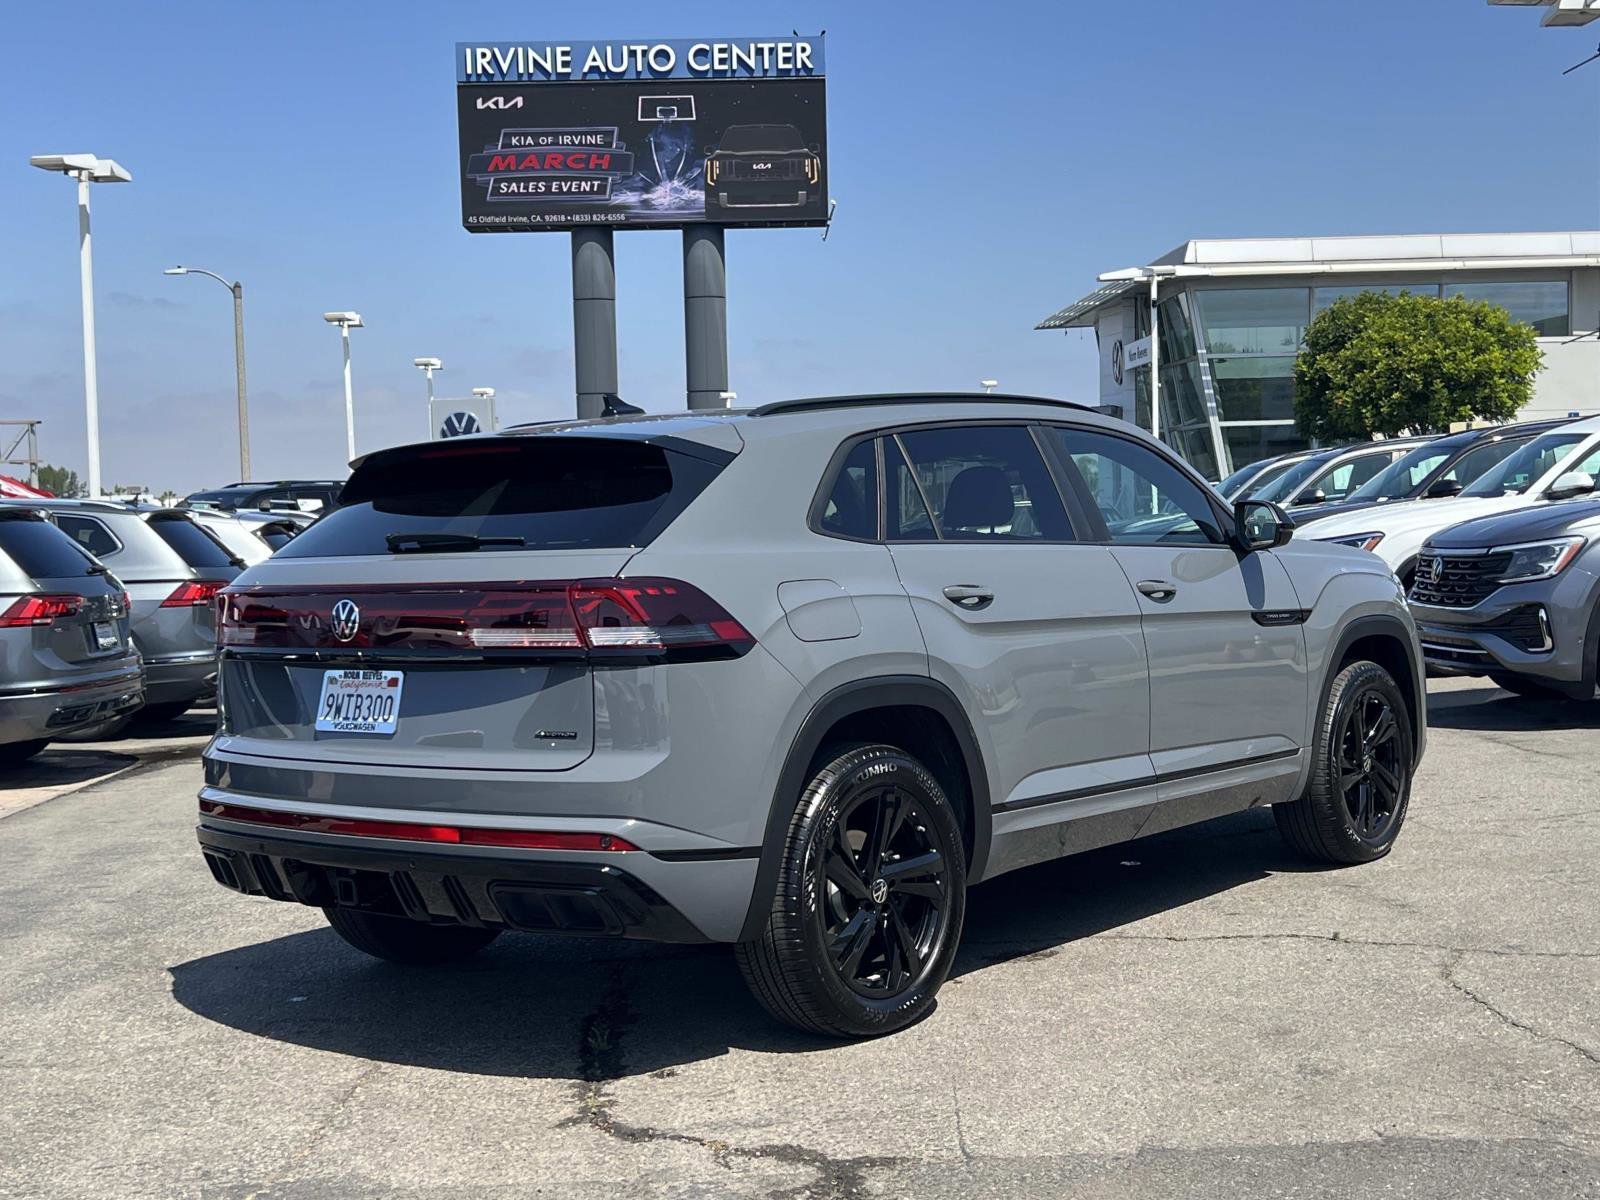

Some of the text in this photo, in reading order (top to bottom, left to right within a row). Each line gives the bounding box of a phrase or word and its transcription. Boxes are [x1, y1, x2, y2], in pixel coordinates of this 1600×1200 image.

[465, 42, 814, 74] IRVINE AUTO CENTER
[511, 134, 605, 146] KIA OF IRVINE
[487, 153, 611, 172] MARCH
[500, 180, 601, 193] SALES EVENT
[478, 215, 507, 223] Oldfield
[544, 214, 566, 222] 92618
[572, 213, 591, 222] (833)
[592, 213, 626, 221] 826-6556
[323, 693, 394, 722] 9WIB300
[333, 722, 376, 731] VOLKSWAGEN
